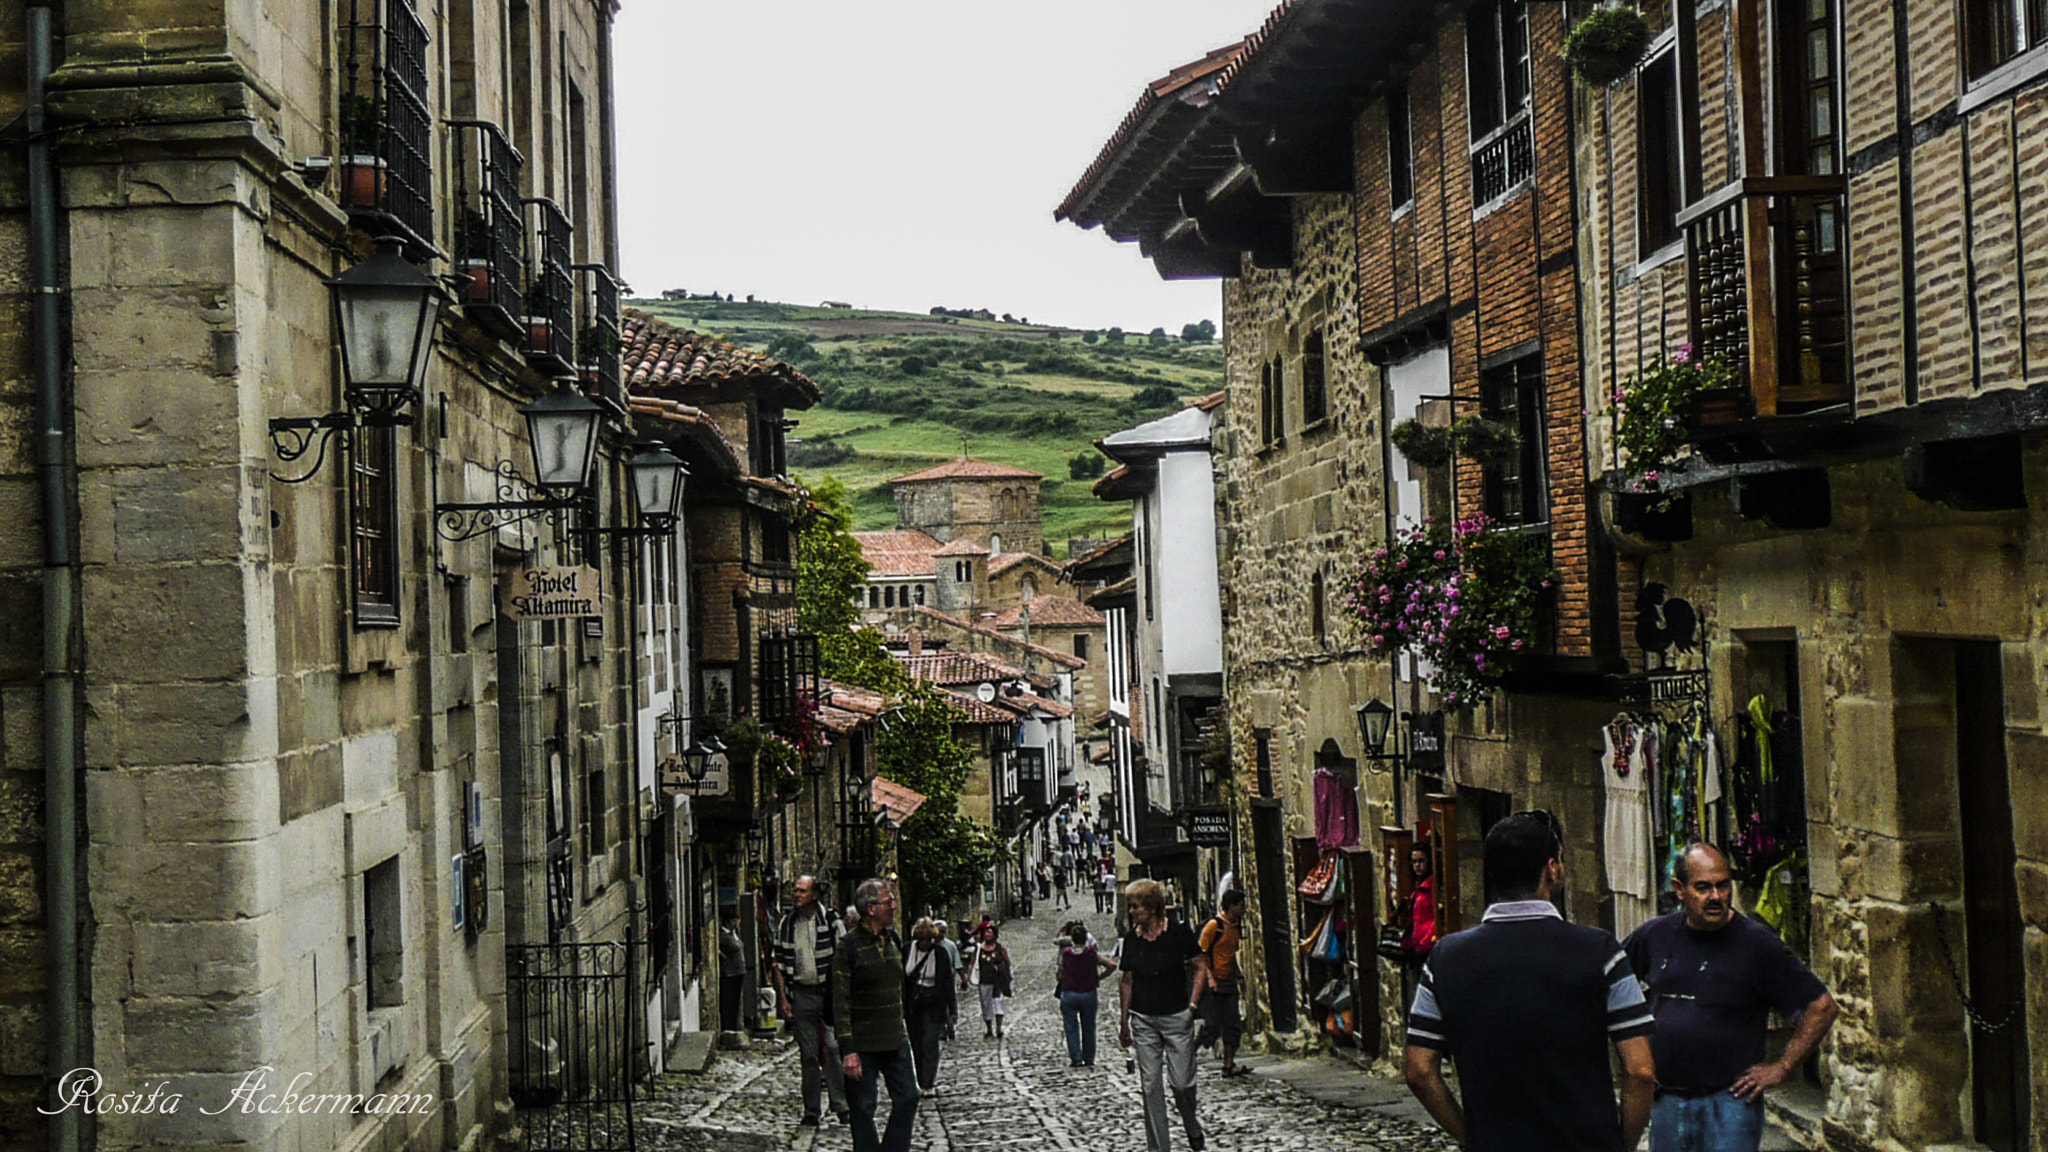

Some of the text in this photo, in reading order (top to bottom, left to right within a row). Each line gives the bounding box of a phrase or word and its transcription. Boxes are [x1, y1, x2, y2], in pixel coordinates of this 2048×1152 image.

[524, 571, 577, 594] Hotel
[511, 593, 592, 616] Altamira
[1195, 816, 1226, 824] POSADA
